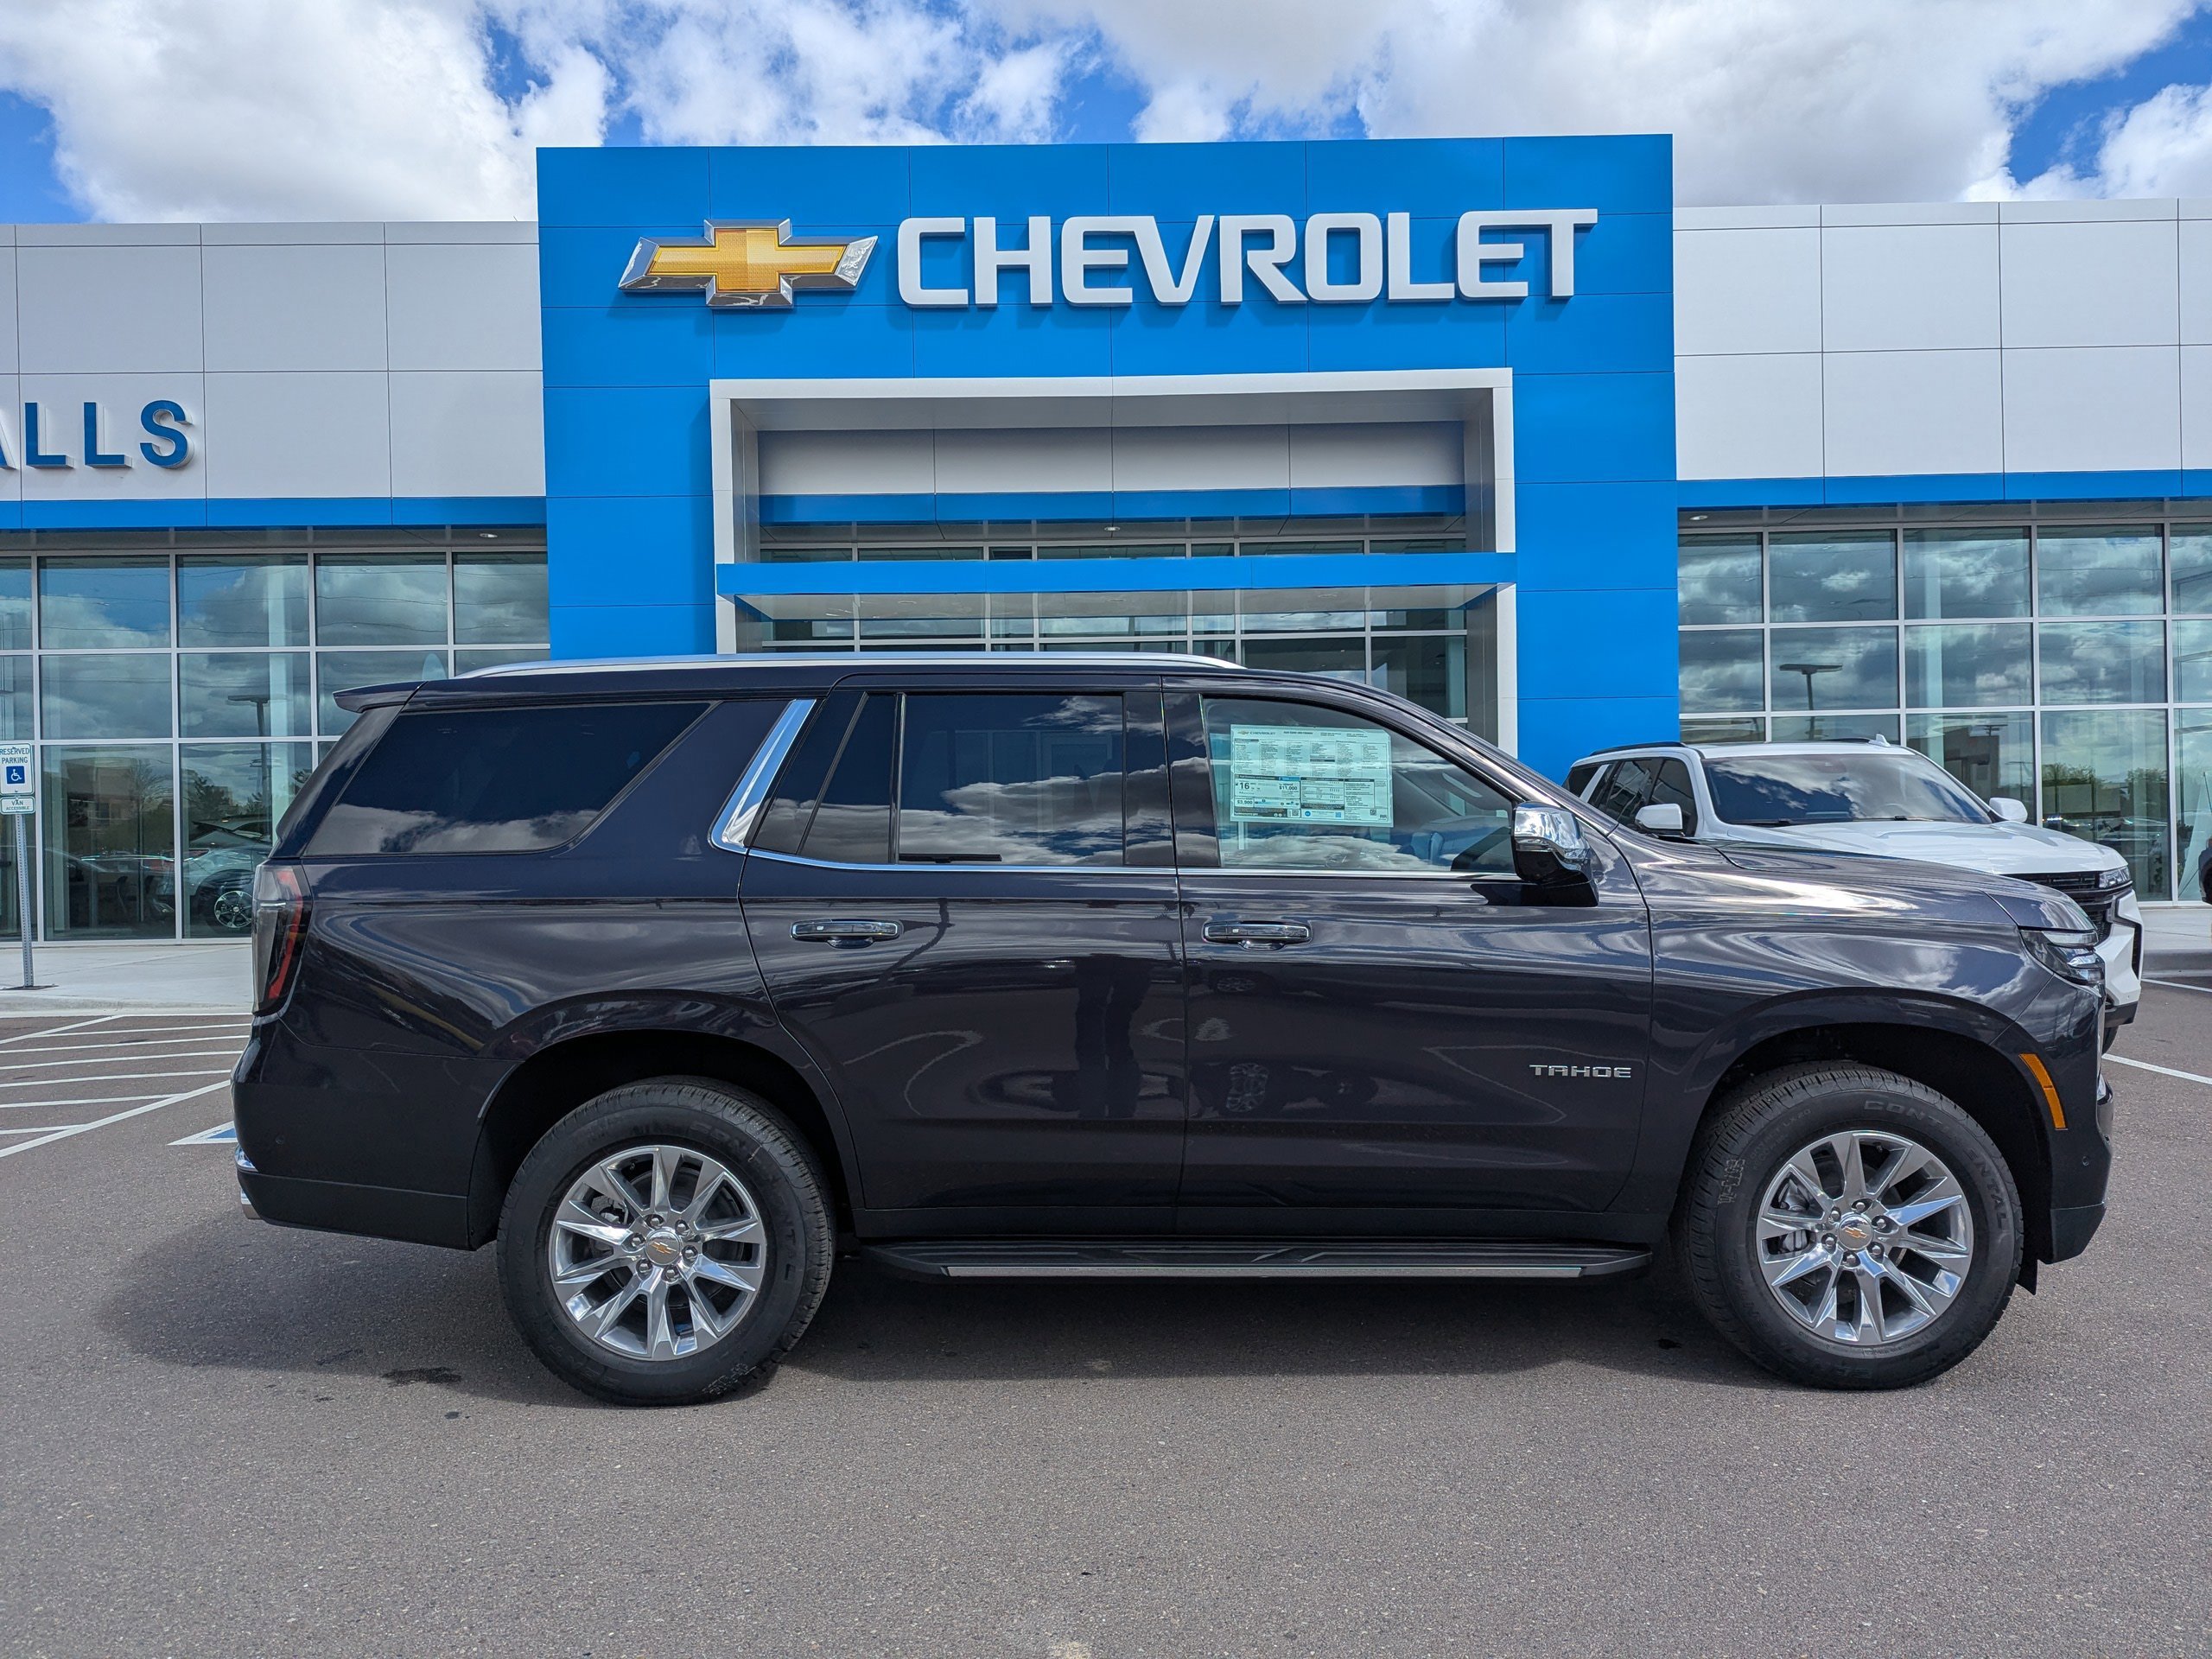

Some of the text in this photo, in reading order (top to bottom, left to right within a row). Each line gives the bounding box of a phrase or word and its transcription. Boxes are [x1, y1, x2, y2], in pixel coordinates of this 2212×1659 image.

[898, 208, 1599, 308] CHEVROLET
[0, 399, 192, 469] LLS
[1529, 1065, 1631, 1077] TAHOE
